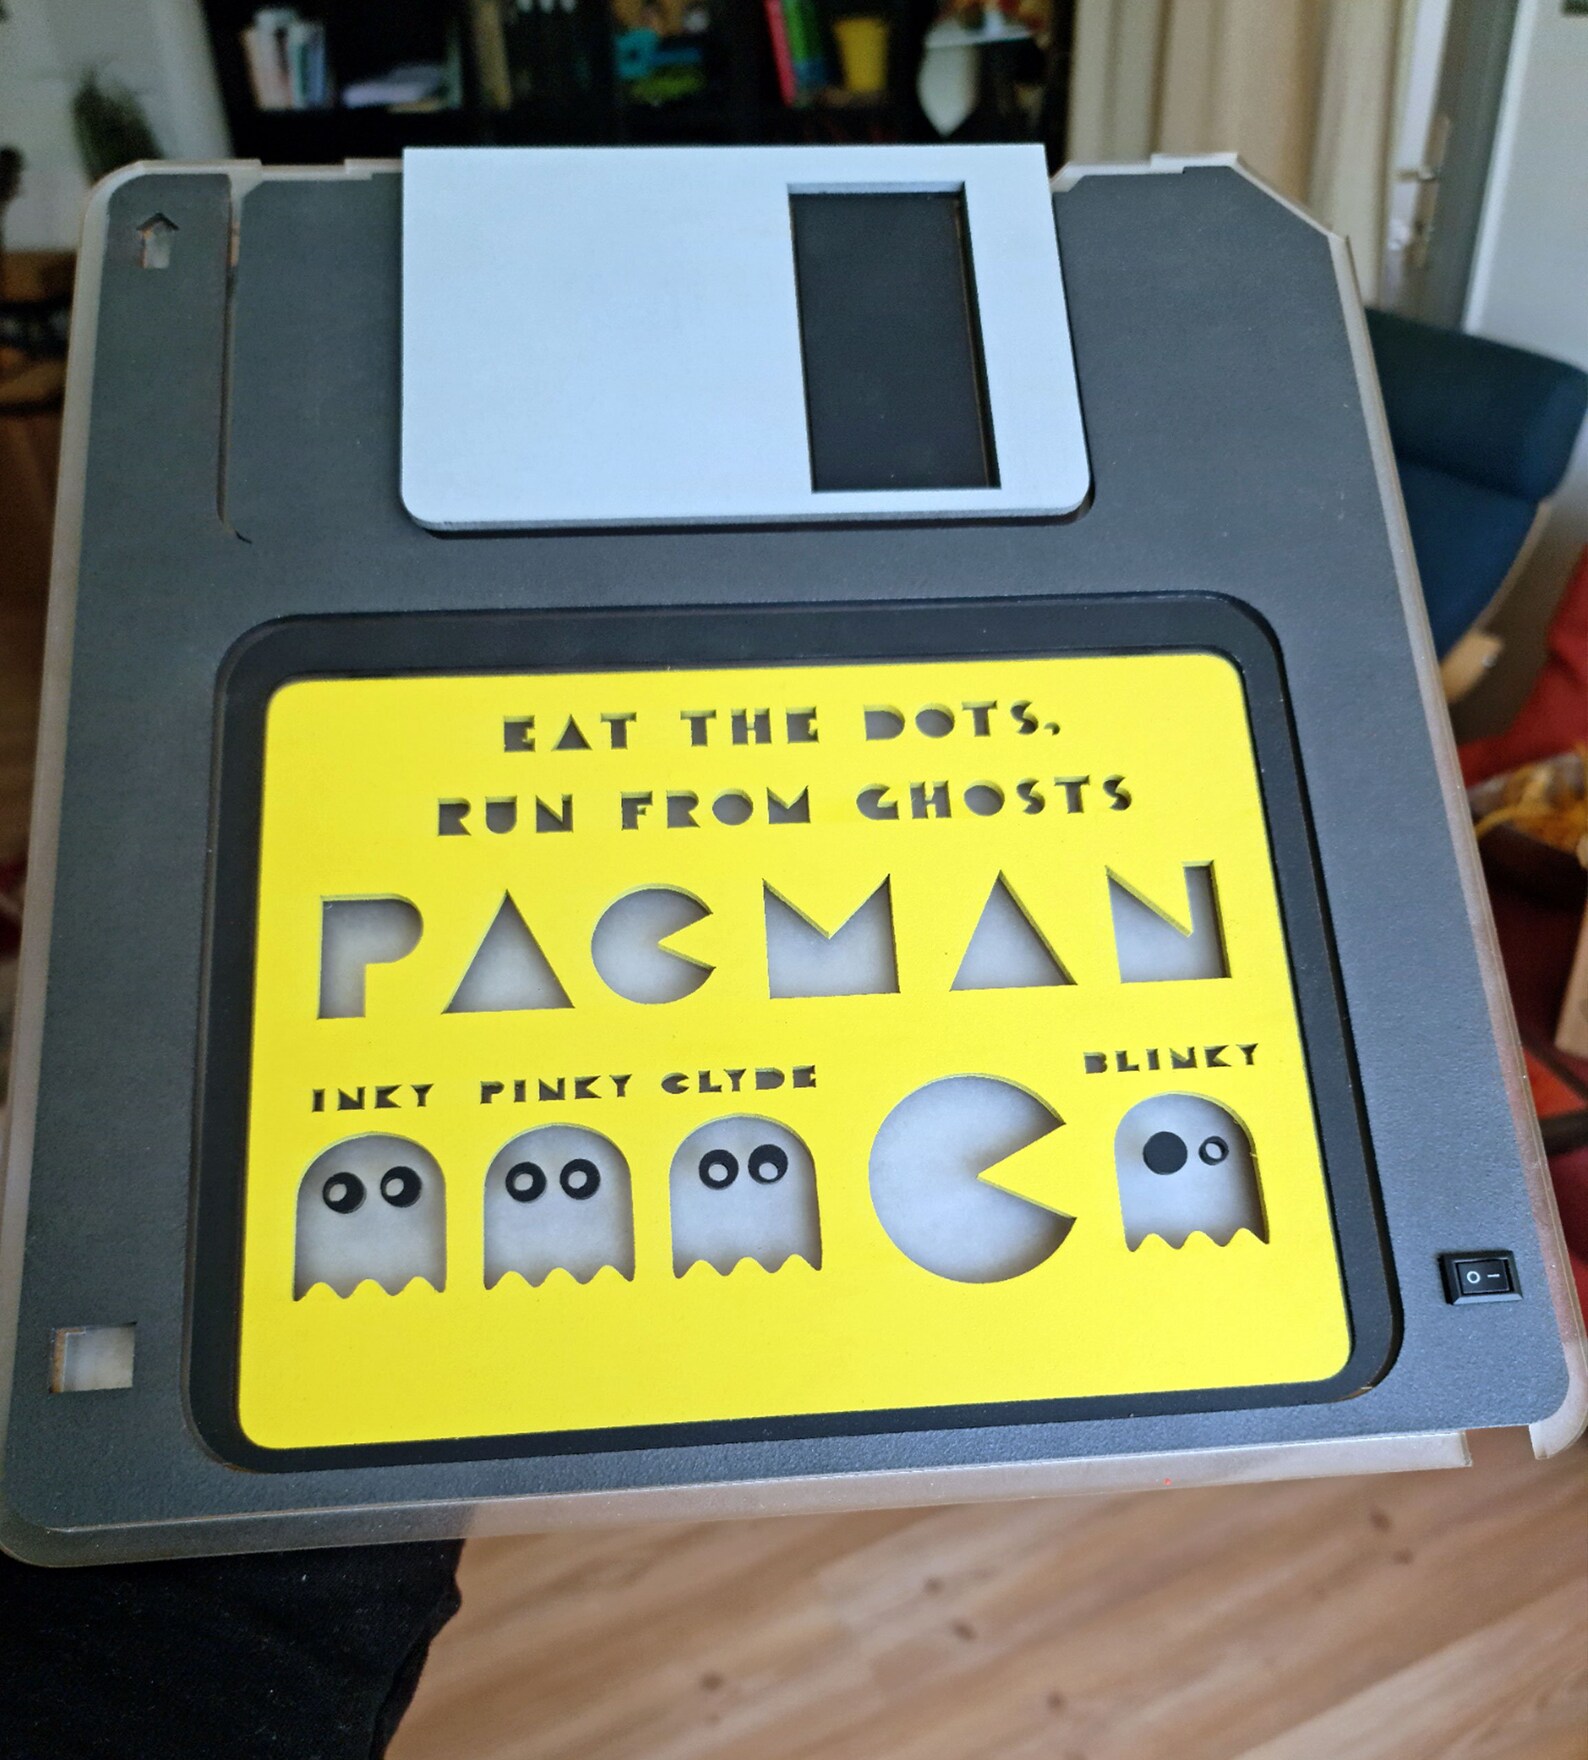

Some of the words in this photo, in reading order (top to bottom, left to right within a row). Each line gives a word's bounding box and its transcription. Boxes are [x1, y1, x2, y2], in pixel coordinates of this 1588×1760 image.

[503, 712, 636, 752] EAT
[680, 707, 819, 746] THE
[864, 701, 1060, 740] DOTS,
[438, 794, 573, 836] RUN
[621, 785, 810, 830] FROM
[856, 775, 1132, 820] GHOSTS
[316, 860, 1232, 1020] PACMAN
[1084, 1043, 1258, 1074] BLINKY
[480, 1074, 632, 1104] PINKY
[661, 1065, 816, 1094] CLYDE
[312, 1084, 434, 1112] INKY
